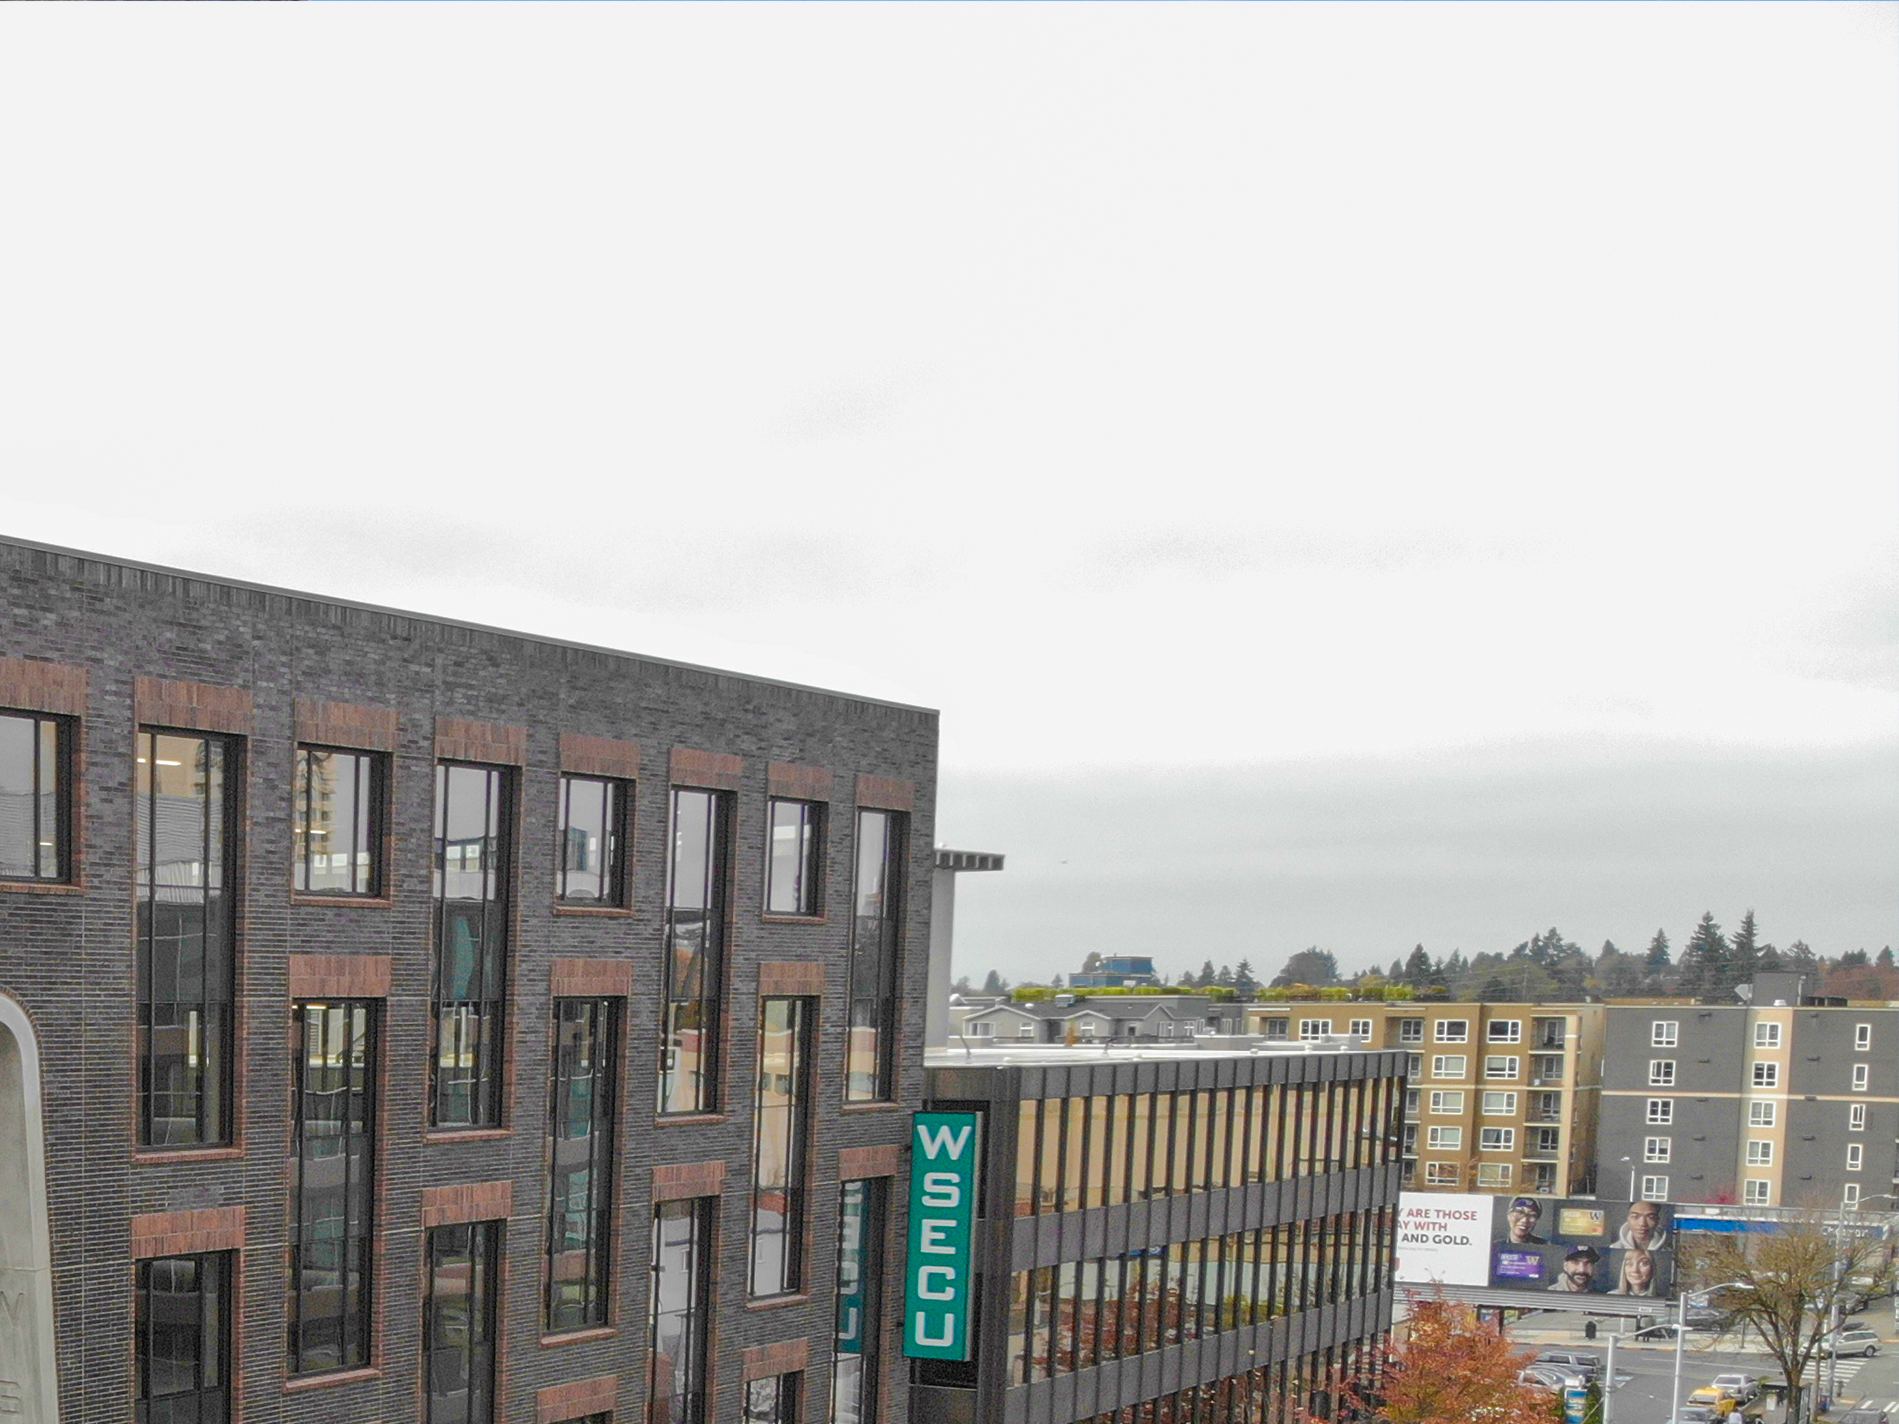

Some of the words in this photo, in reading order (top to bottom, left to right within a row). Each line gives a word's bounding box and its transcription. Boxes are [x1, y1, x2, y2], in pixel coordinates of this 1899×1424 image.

[1406, 1208, 1431, 1219] ARE
[1434, 1209, 1478, 1221] THOSE
[1414, 1221, 1448, 1232] WITH
[915, 1124, 973, 1348] WSECU
[1401, 1233, 1429, 1244] AND
[1432, 1234, 1473, 1246] GOLD.
